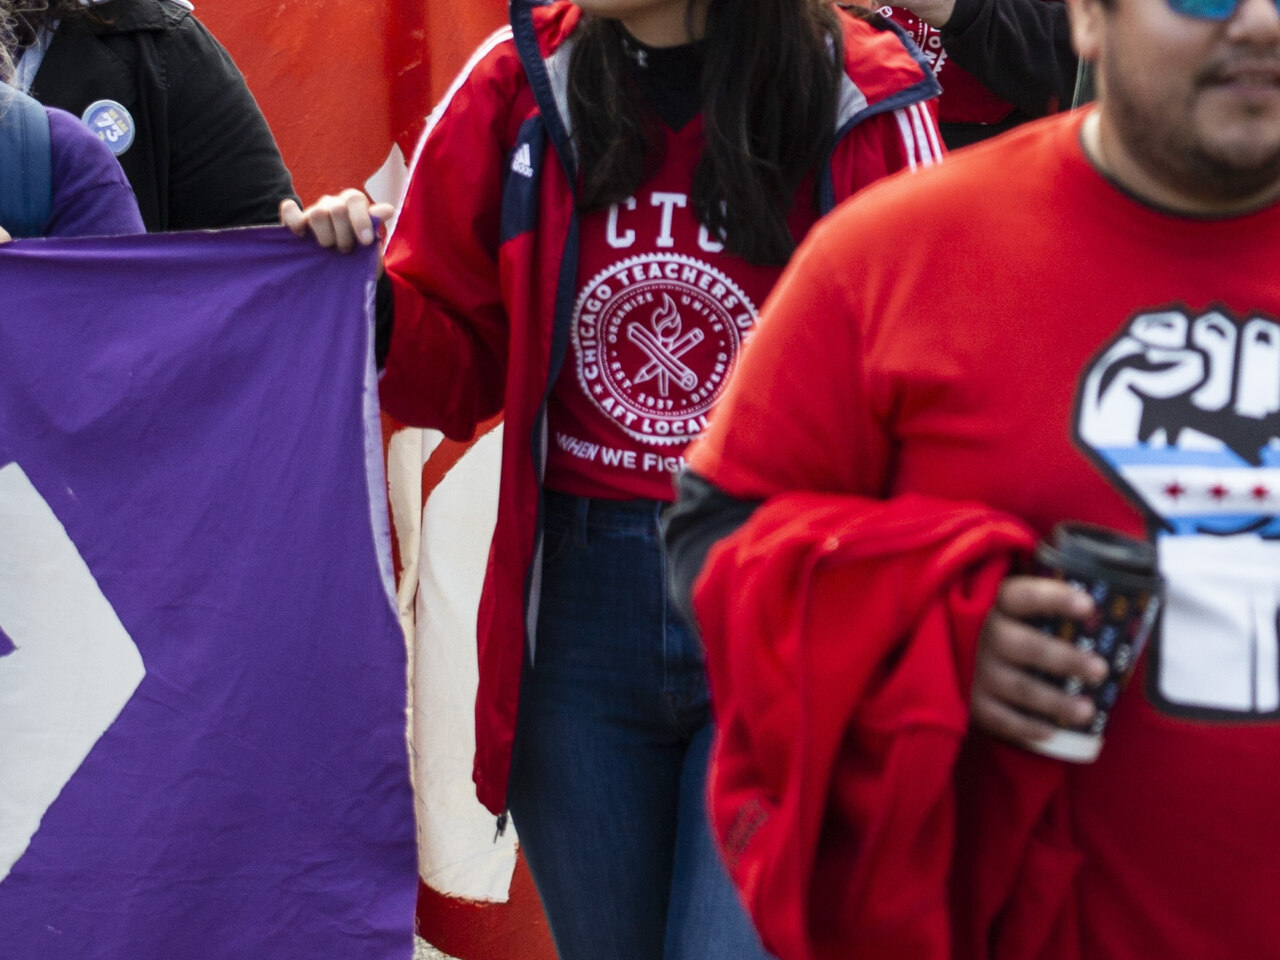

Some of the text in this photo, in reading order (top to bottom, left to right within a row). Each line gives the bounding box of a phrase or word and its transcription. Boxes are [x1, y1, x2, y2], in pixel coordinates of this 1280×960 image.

[96, 111, 124, 143] 73
[582, 283, 613, 382] CHICAGO
[616, 262, 740, 311] TEACHERS
[608, 291, 729, 406] ORGANIZE UNITE DEFEND
[601, 396, 638, 427] AFT
[636, 391, 675, 411] 1937
[555, 431, 600, 462] WHEN
[600, 446, 637, 470] WE
